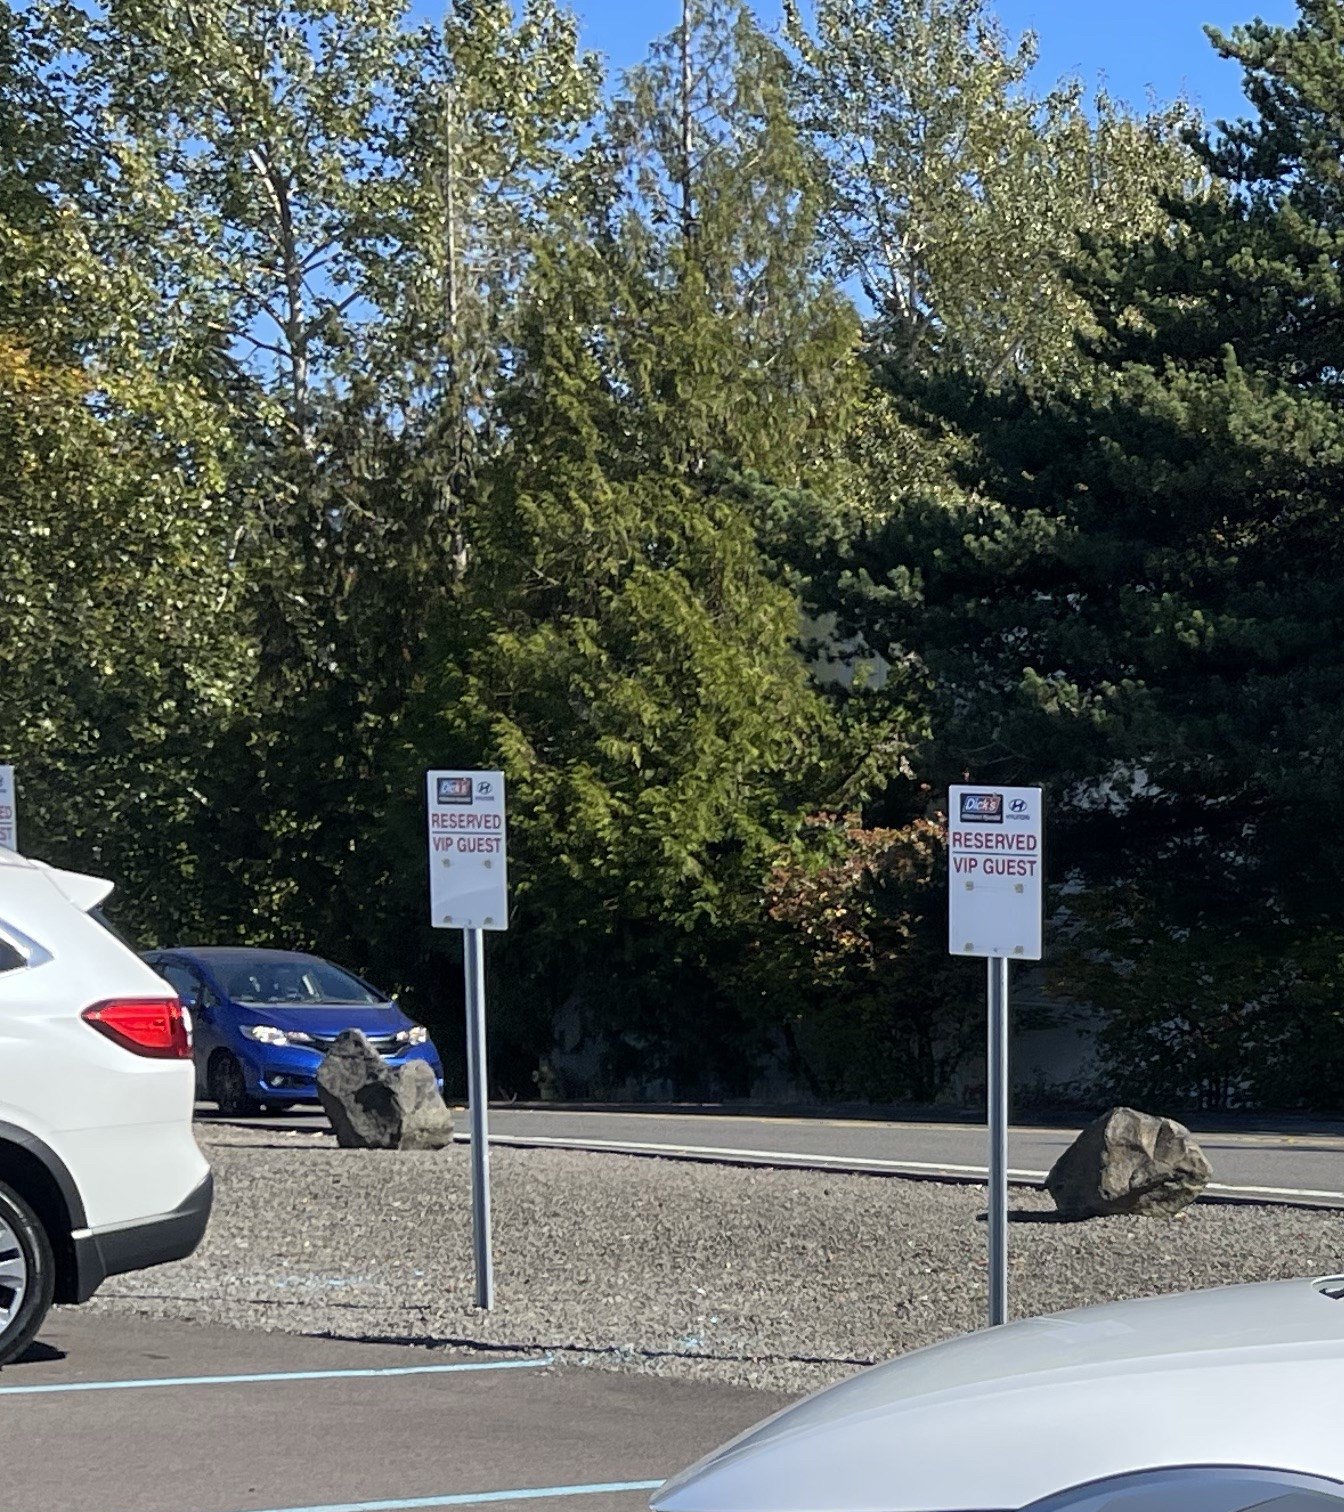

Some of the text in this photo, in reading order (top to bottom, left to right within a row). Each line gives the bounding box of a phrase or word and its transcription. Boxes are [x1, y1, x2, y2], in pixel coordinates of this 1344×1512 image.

[431, 813, 501, 830] RESERVED
[433, 836, 502, 854] VIP GUEST
[952, 831, 1038, 851] RESERVED
[953, 857, 1038, 876] VIP GUEST
